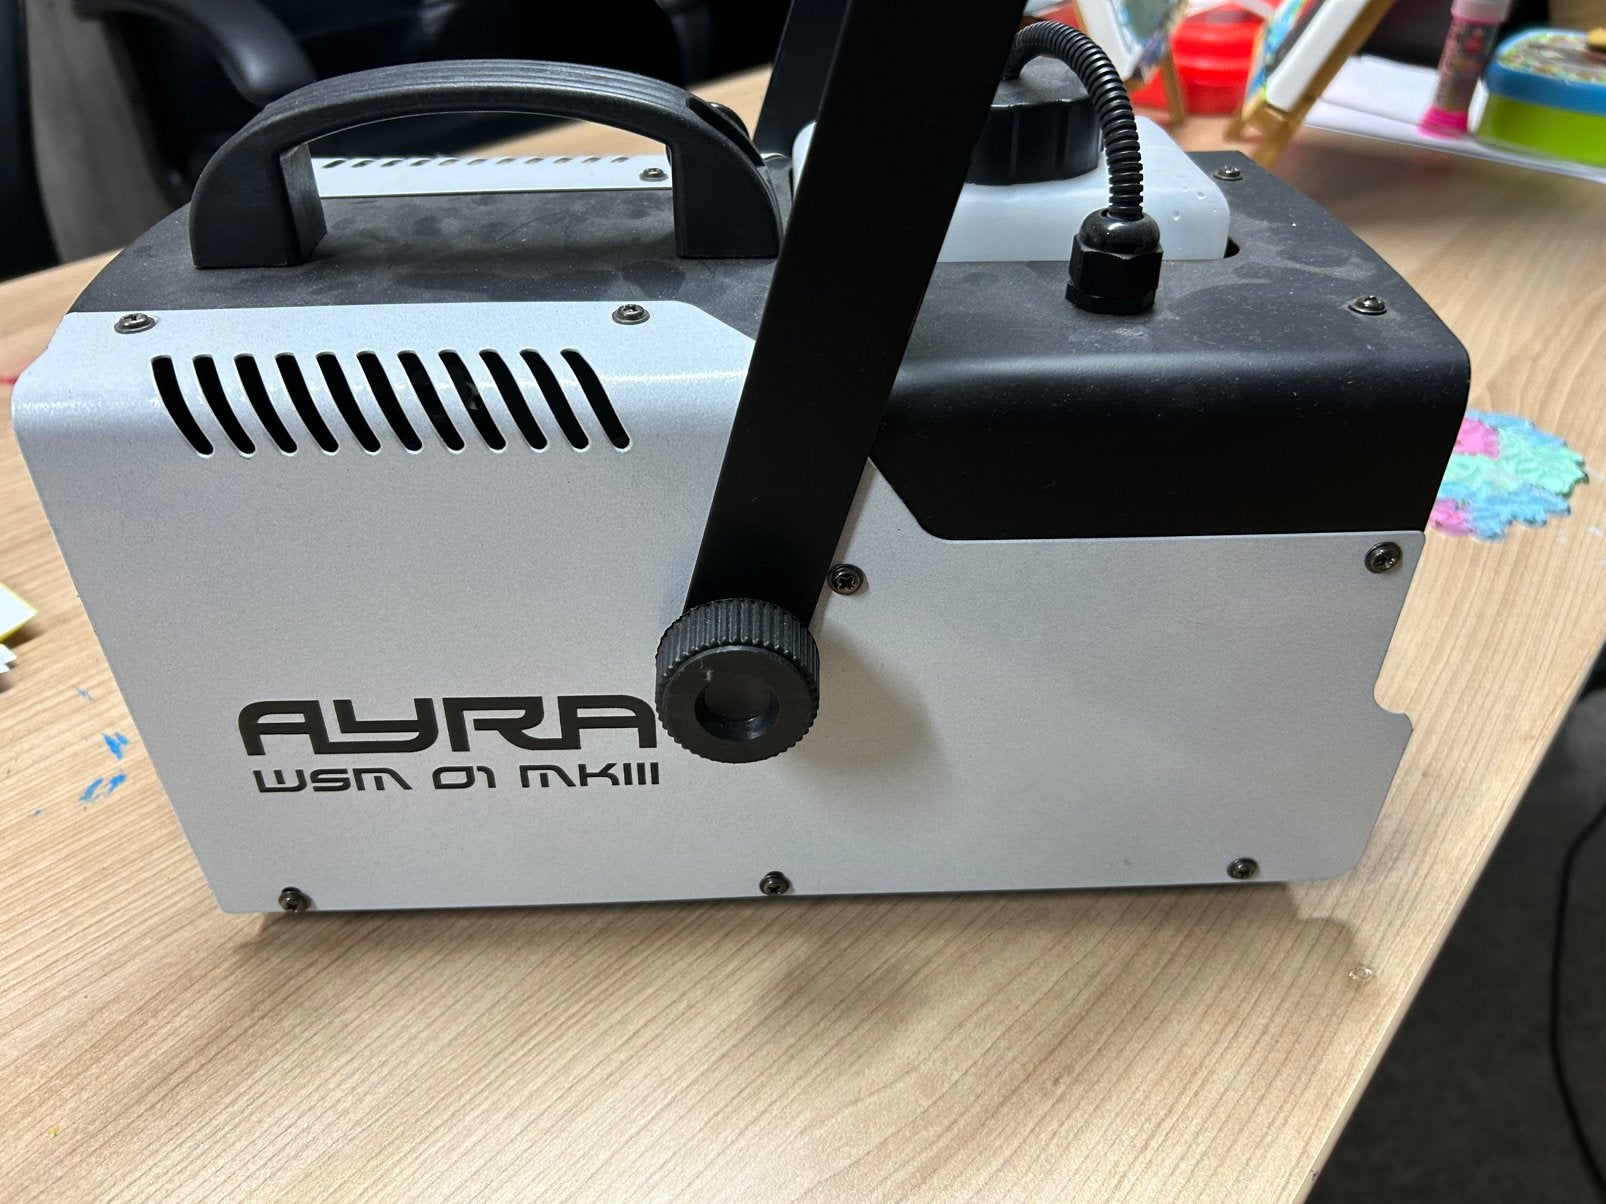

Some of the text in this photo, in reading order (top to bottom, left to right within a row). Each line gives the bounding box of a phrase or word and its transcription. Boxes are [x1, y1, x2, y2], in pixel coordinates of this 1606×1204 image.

[238, 695, 657, 755] AYRA
[253, 767, 413, 793] WSM
[432, 765, 497, 790] 01
